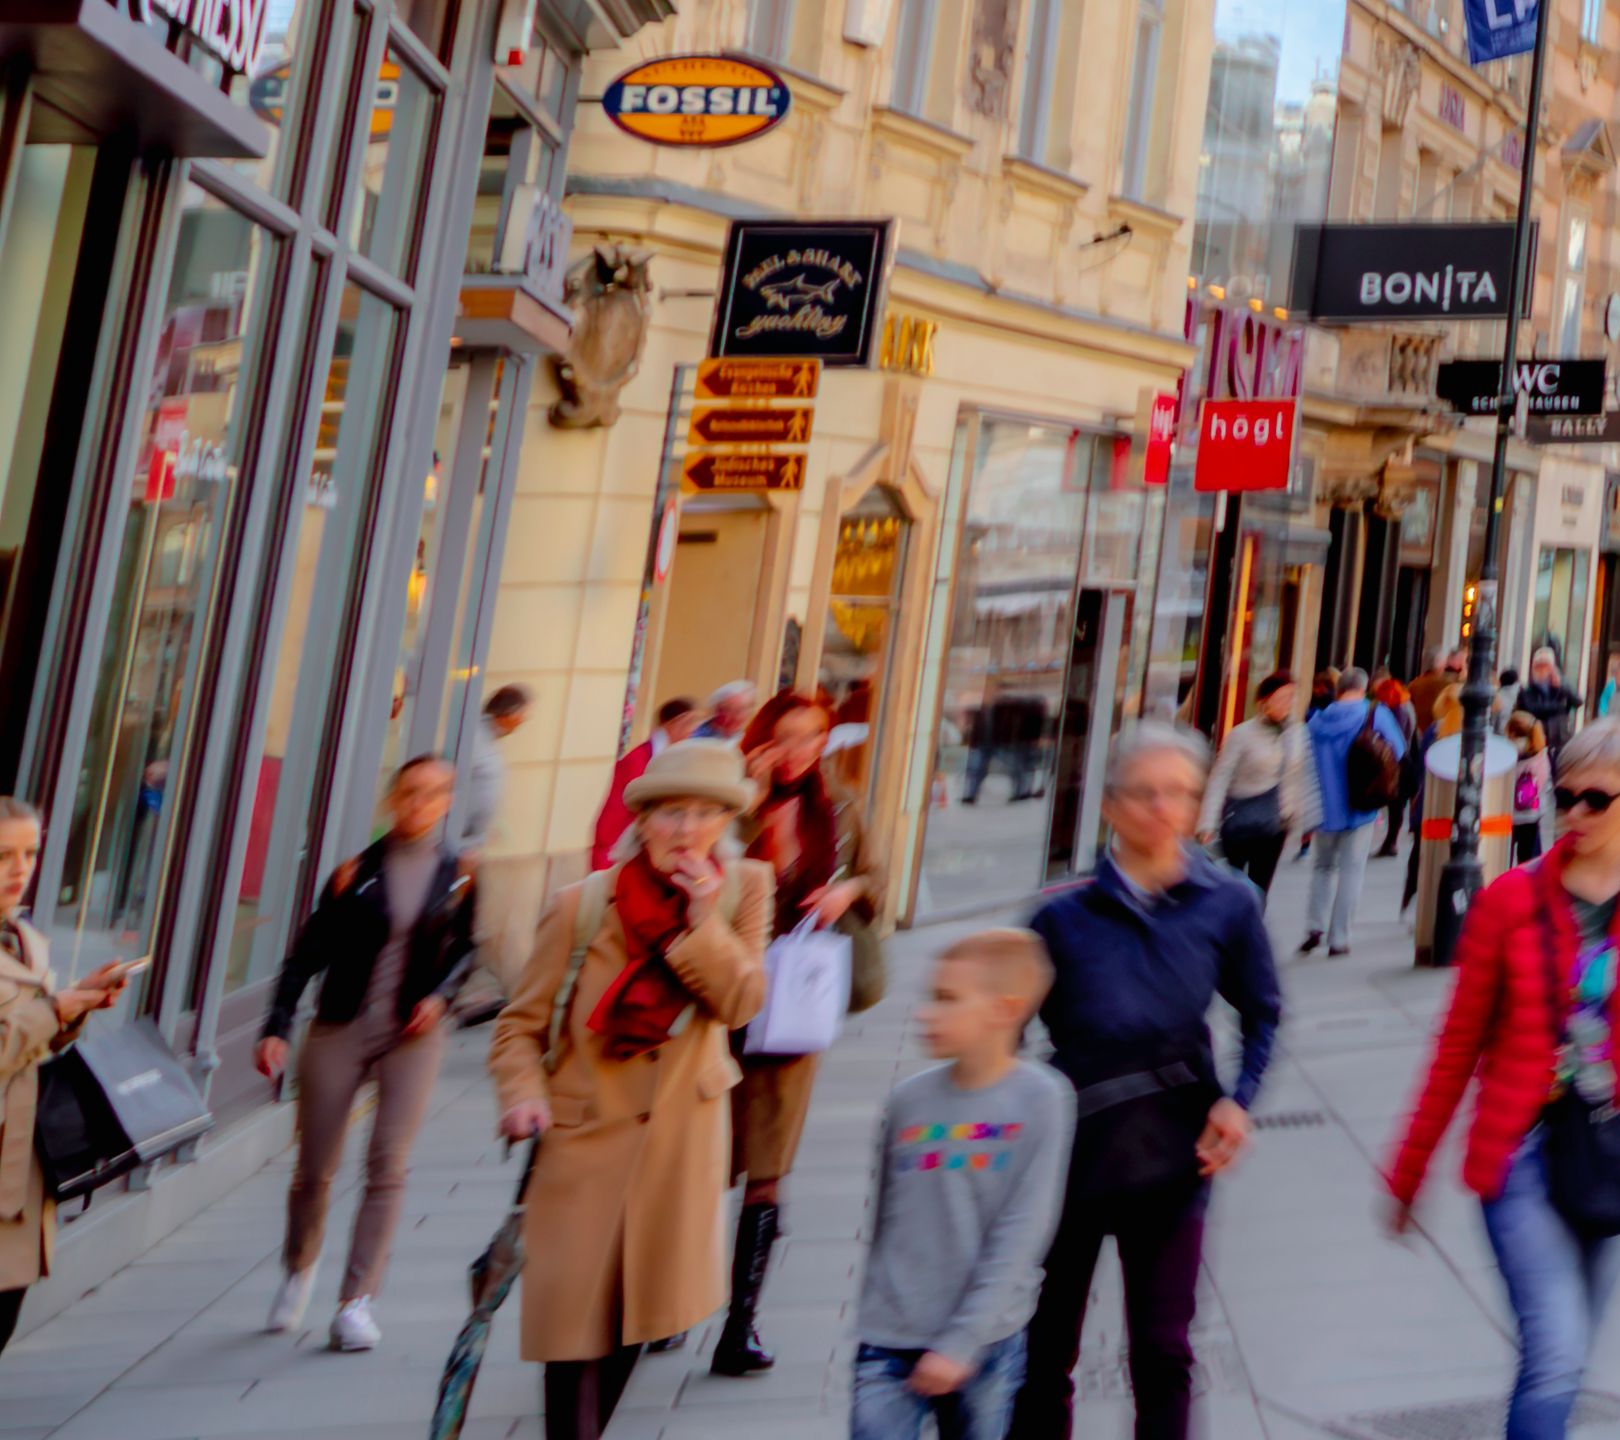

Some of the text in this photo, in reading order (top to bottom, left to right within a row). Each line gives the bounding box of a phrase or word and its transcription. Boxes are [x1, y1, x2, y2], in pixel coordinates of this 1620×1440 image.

[620, 84, 777, 116] FOSSIL
[1360, 264, 1497, 312] BONITA
[1210, 410, 1284, 447] högl
